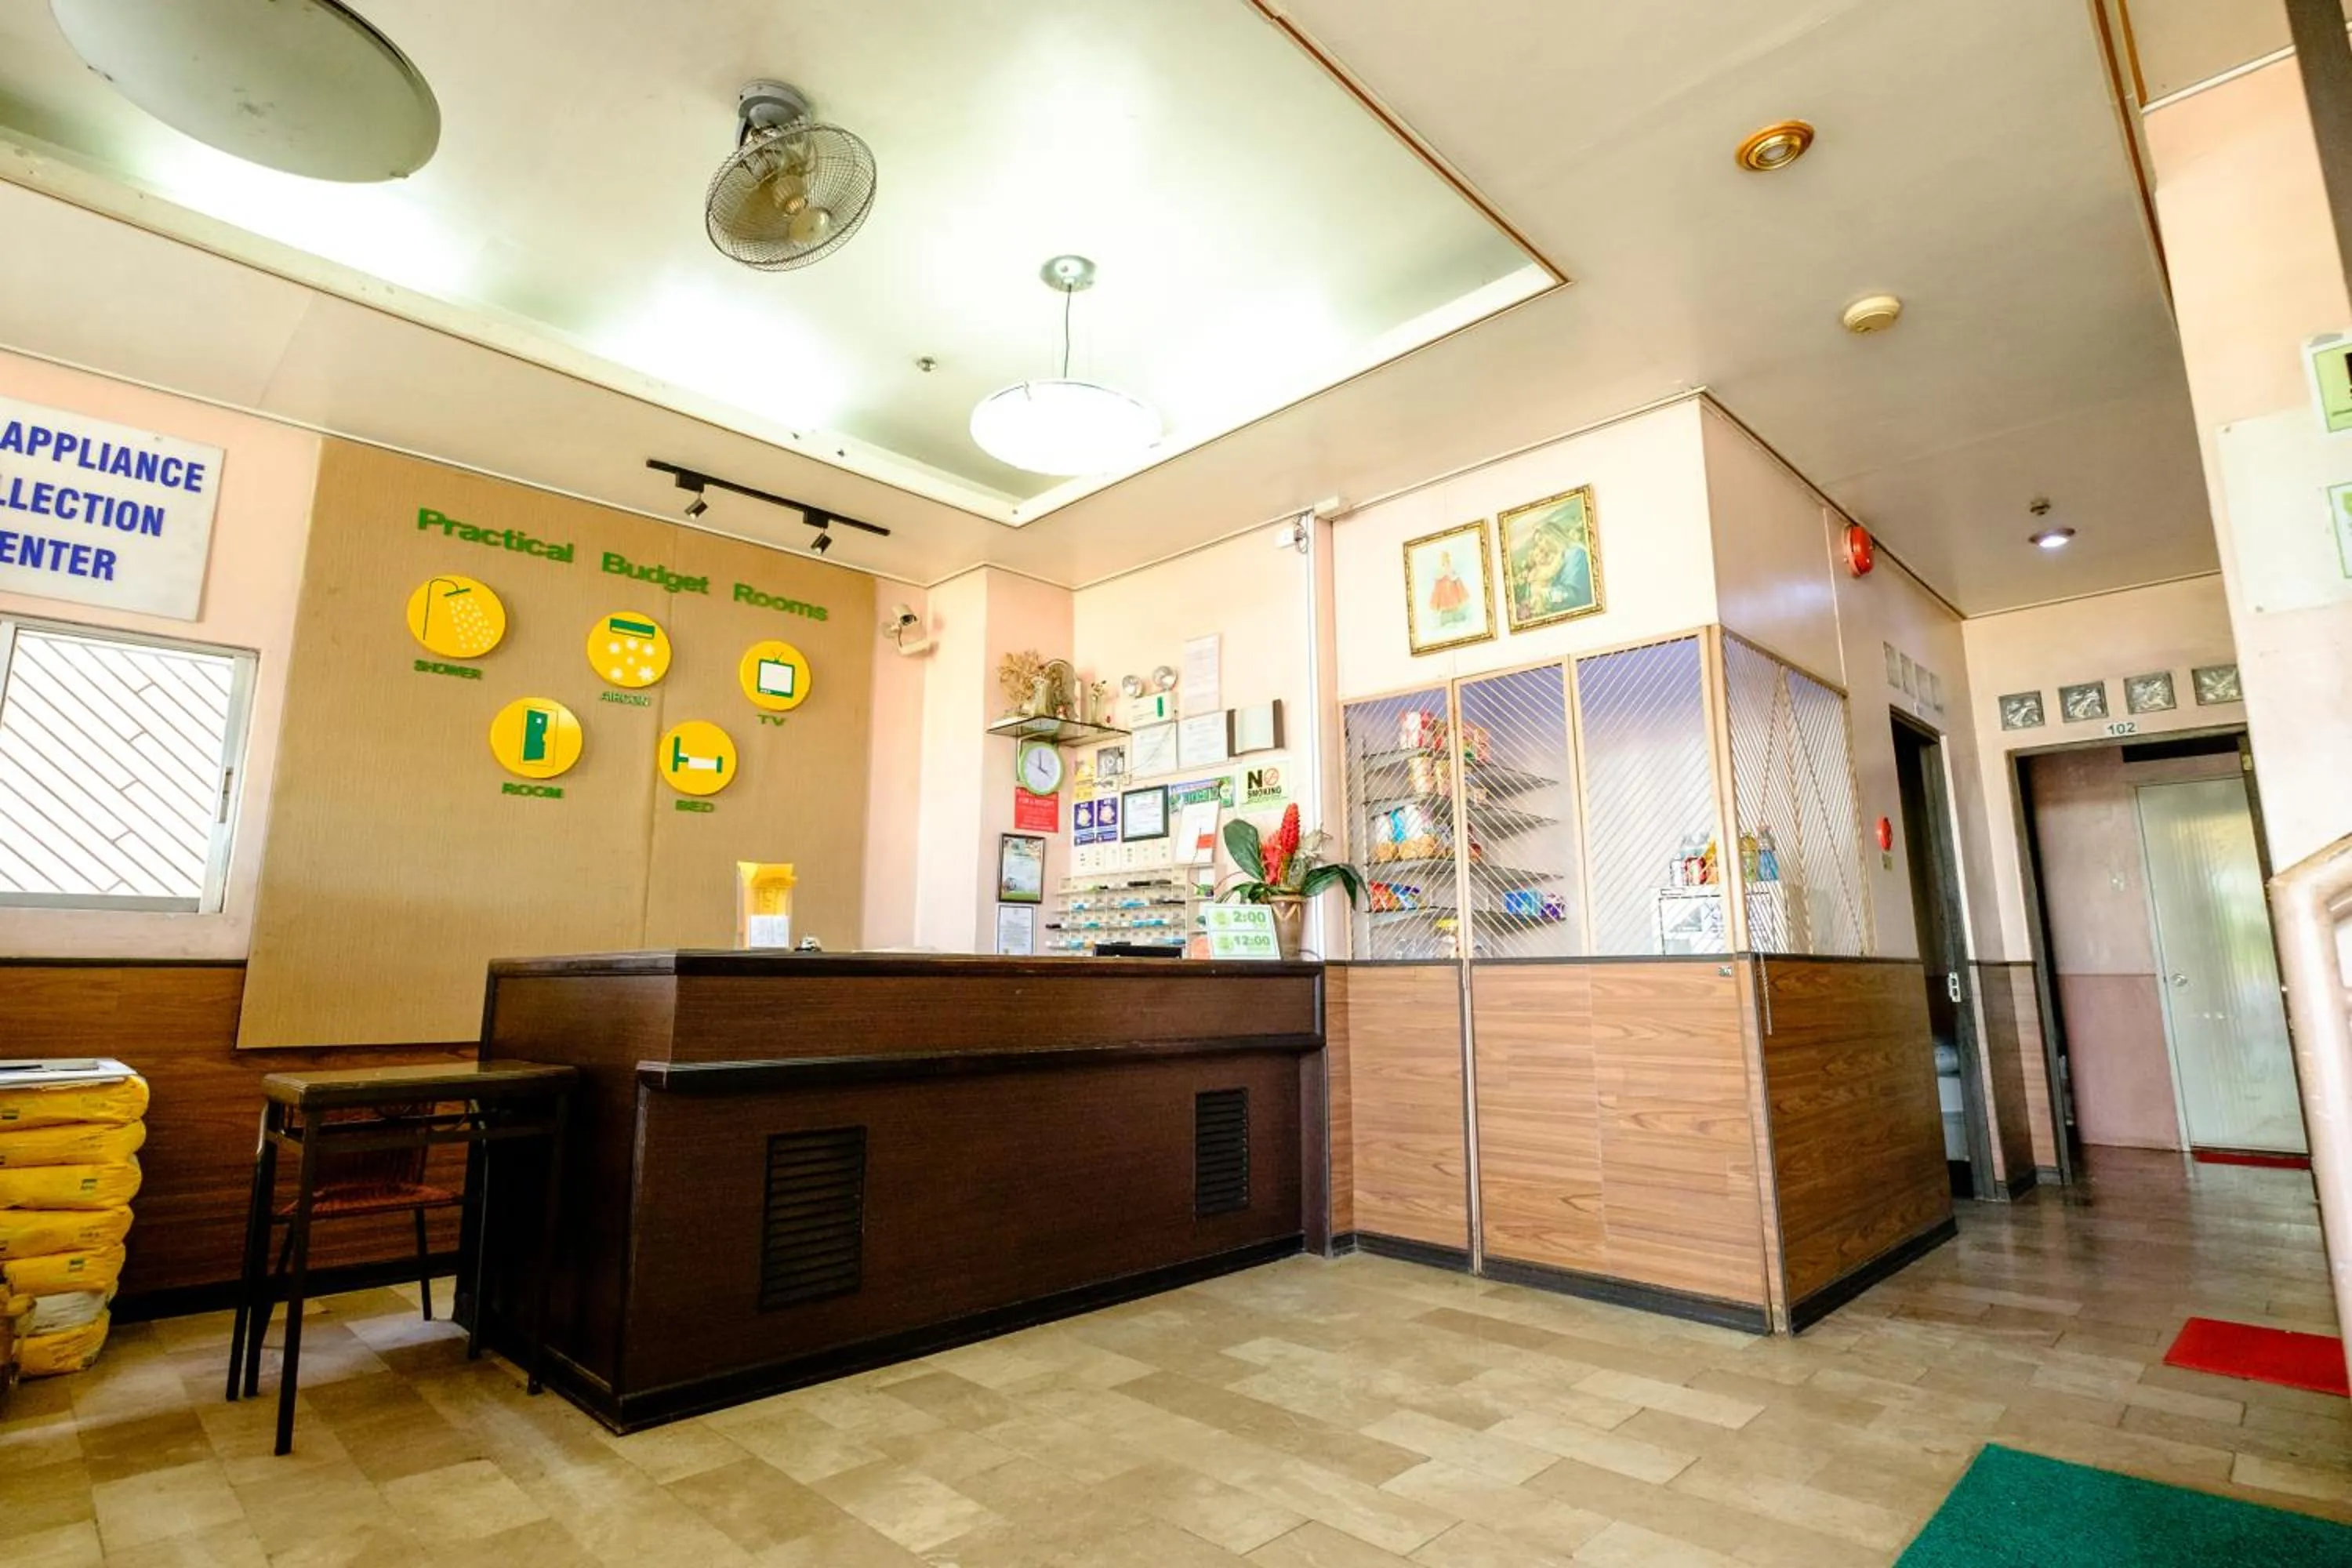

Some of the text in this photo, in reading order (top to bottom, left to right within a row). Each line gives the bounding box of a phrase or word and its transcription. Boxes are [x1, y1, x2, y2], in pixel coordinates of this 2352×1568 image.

[1, 421, 205, 493] APPLIANCE
[417, 507, 829, 622] Practical Budget Rooms
[413, 659, 483, 681] SHOWER
[756, 713, 787, 727] TV
[2107, 721, 2136, 735] 102
[502, 782, 564, 800] ROOM
[675, 800, 715, 814] BED
[1232, 910, 1266, 924] 2:00
[1233, 934, 1271, 947] 12:00
